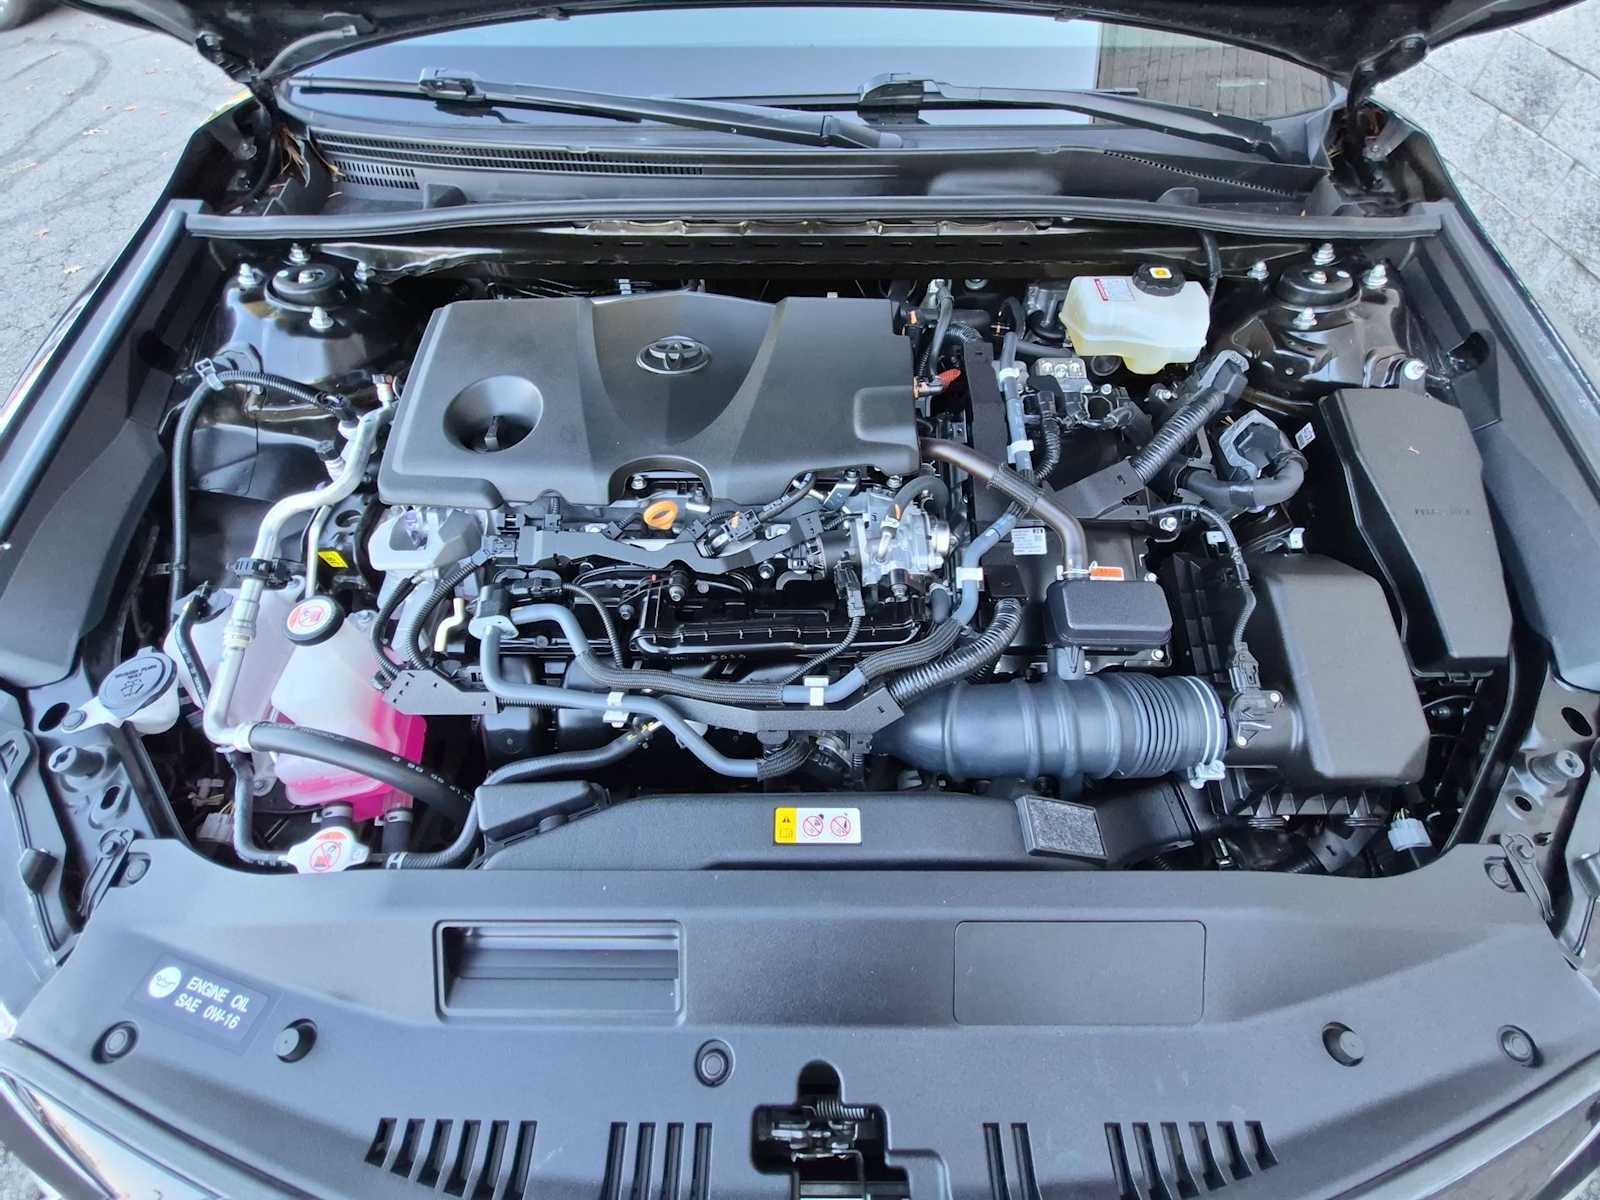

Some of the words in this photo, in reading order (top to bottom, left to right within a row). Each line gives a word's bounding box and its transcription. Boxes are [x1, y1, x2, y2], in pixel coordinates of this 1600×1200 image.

[175, 993, 202, 1013] SAE
[203, 1005, 241, 1029] 0W-16
[187, 976, 230, 1002] ENGINE
[230, 994, 250, 1012] OIL
